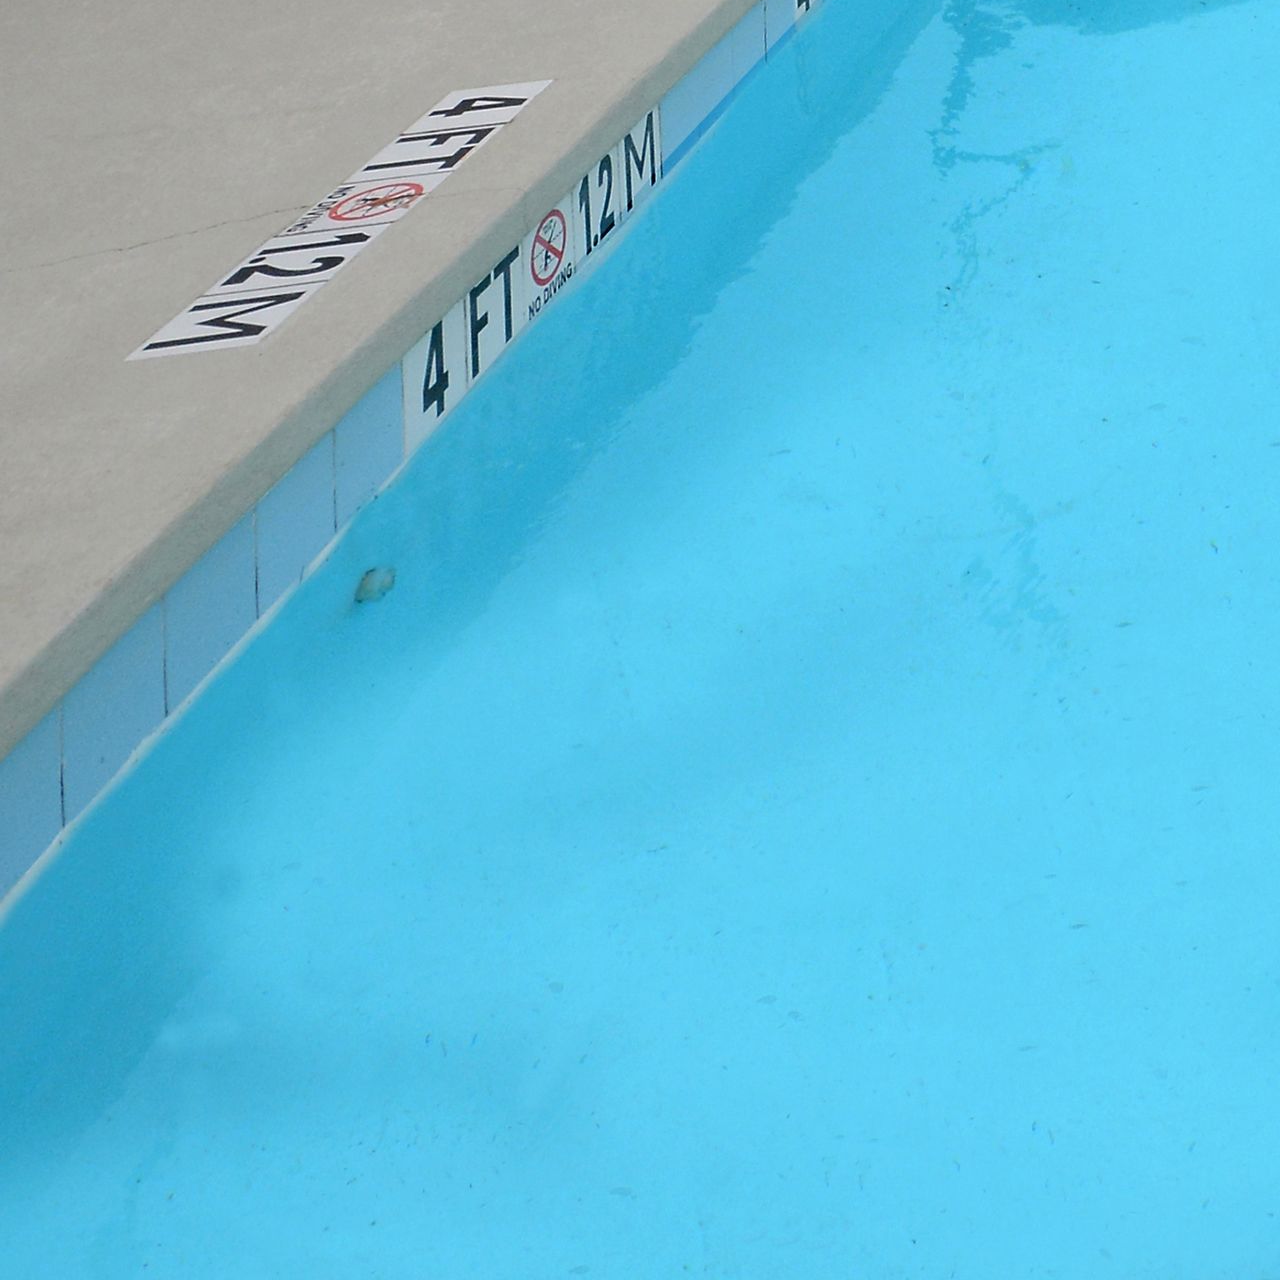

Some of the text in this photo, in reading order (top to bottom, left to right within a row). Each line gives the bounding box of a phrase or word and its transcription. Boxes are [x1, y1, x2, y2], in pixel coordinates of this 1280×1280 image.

[142, 96, 528, 352] 4 FT 1.2 M
[422, 112, 657, 418] 4 FT 1.2 M
[528, 262, 573, 321] NO DIVING
